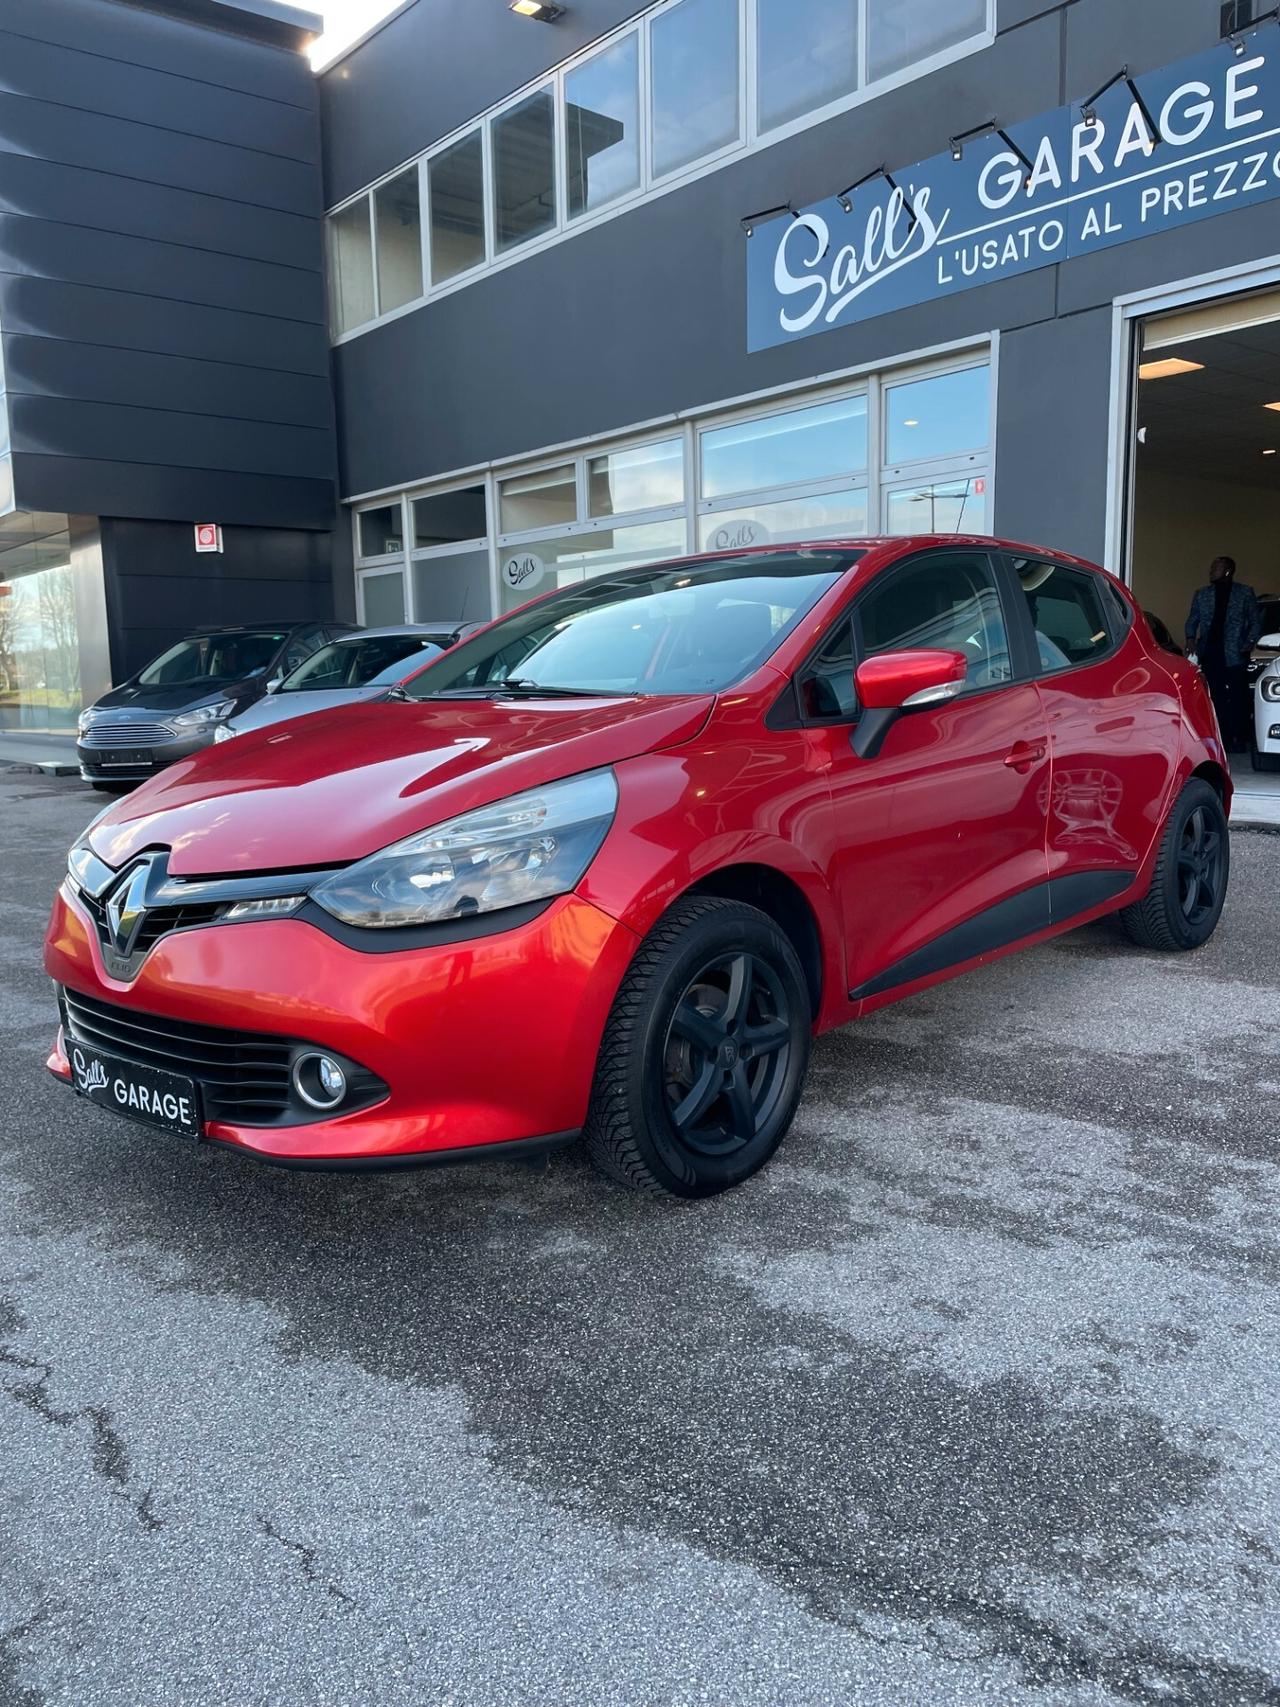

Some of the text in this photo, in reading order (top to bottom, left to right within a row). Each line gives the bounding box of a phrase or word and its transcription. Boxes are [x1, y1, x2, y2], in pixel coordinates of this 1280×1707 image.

[977, 56, 1266, 210] GARAGE
[936, 220, 1064, 284] L'USATO
[1080, 204, 1123, 241] AL
[114, 1079, 191, 1125] GARAGE
